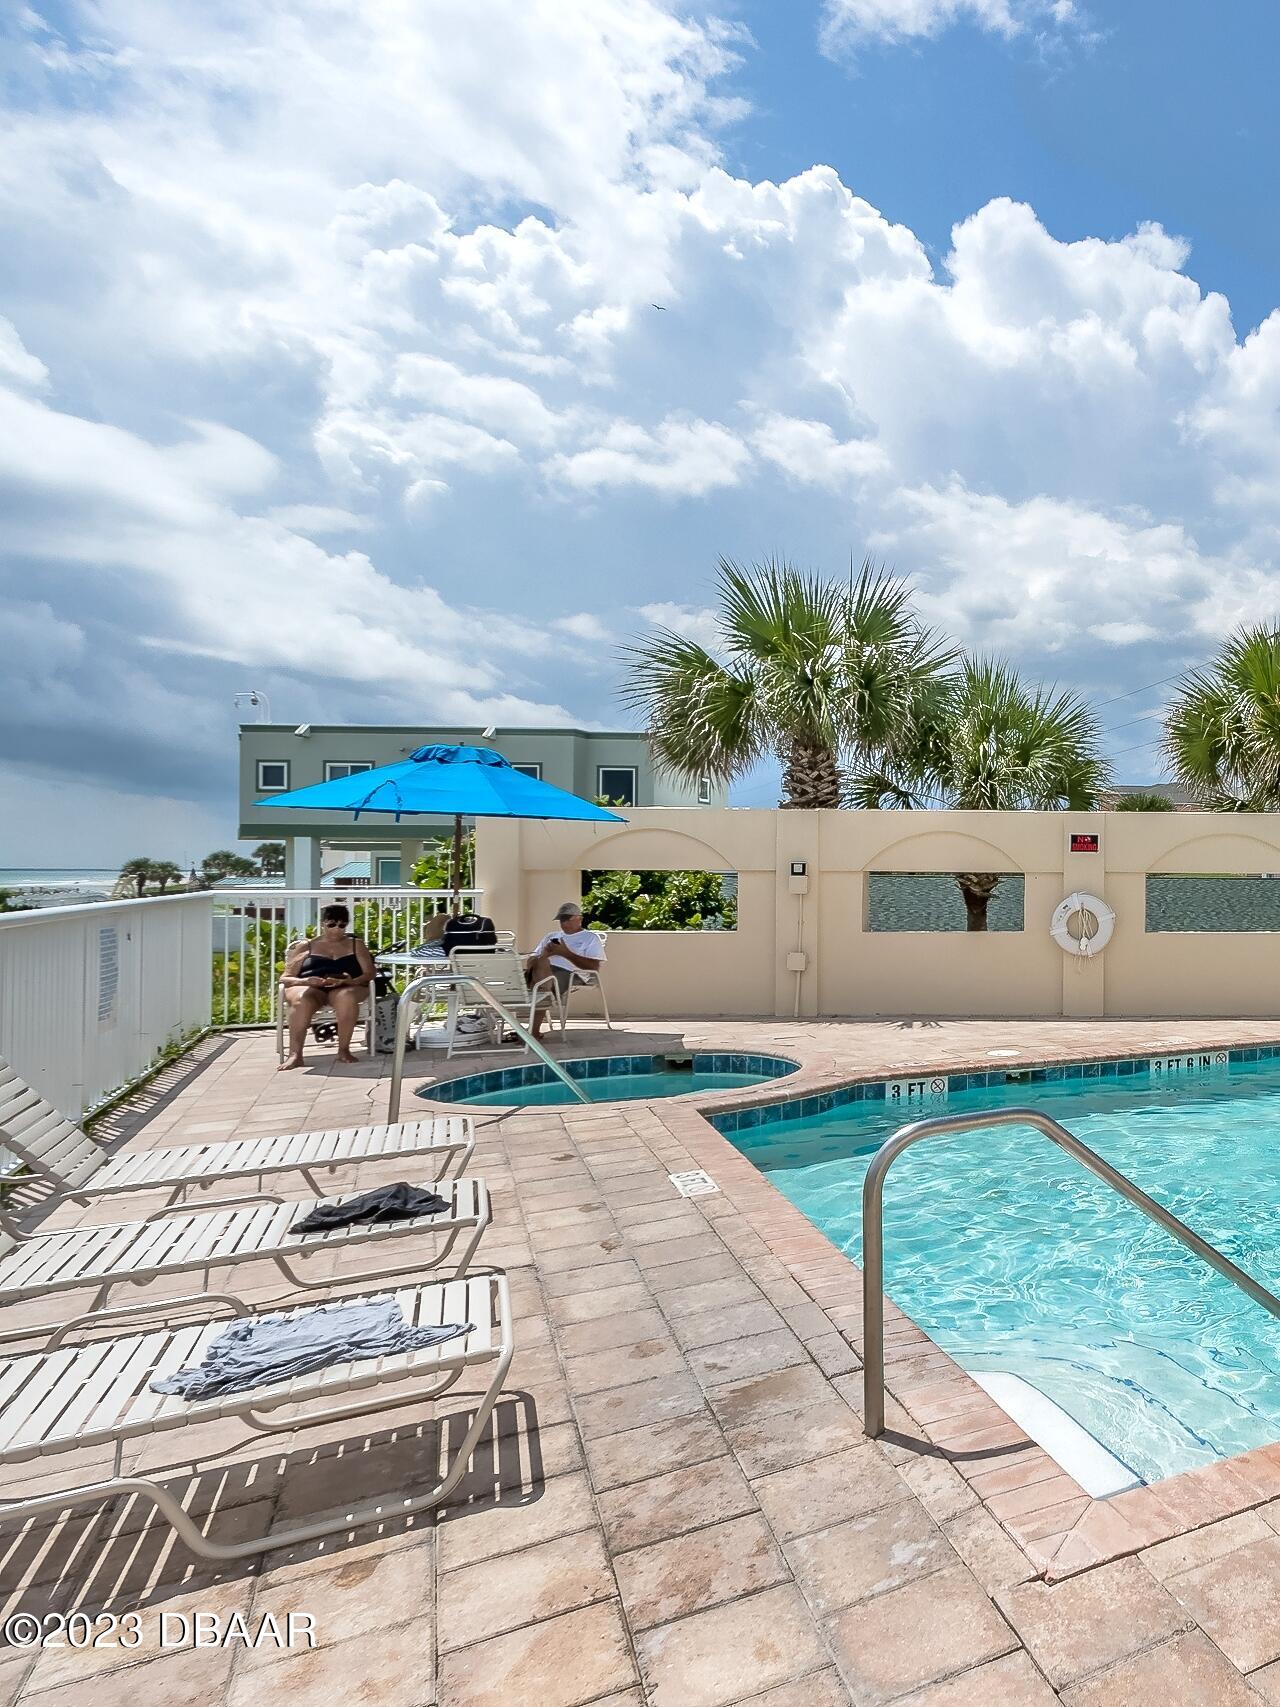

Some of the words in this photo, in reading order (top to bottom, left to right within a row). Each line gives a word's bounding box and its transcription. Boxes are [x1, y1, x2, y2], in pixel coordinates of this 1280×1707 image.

[1167, 1058, 1182, 1069] FT
[1199, 1055, 1211, 1066] IN
[891, 1084, 901, 1098] 3
[907, 1081, 926, 1097] FT
